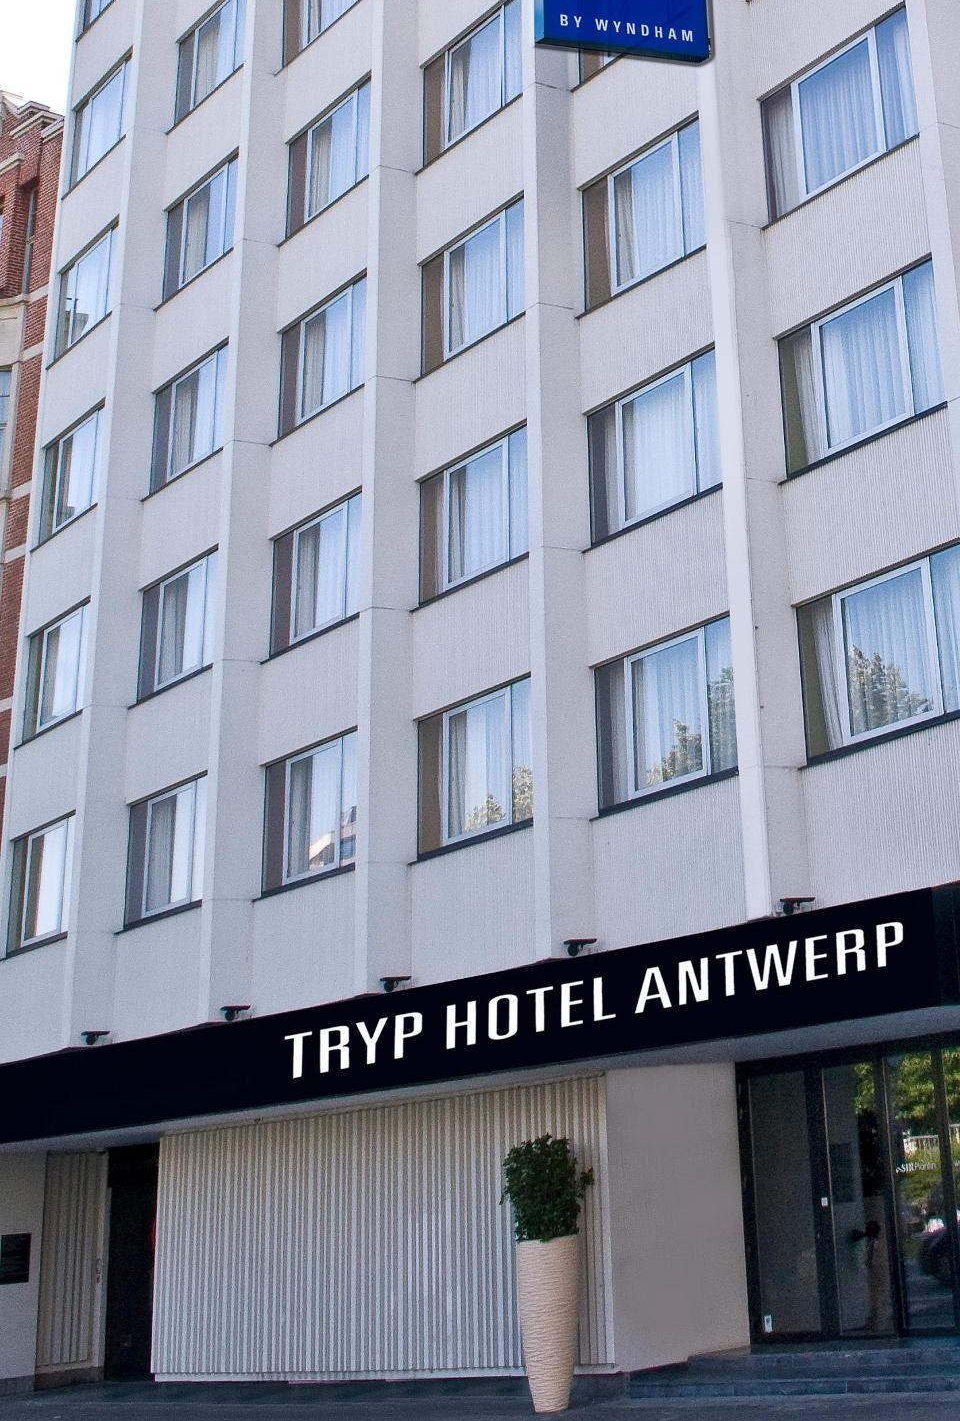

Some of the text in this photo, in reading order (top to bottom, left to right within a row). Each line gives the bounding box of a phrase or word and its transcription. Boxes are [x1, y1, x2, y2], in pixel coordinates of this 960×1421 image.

[559, 13, 694, 43] BY WYNDHAM
[284, 921, 904, 1079] TRYP HOTEL ANTWERP
